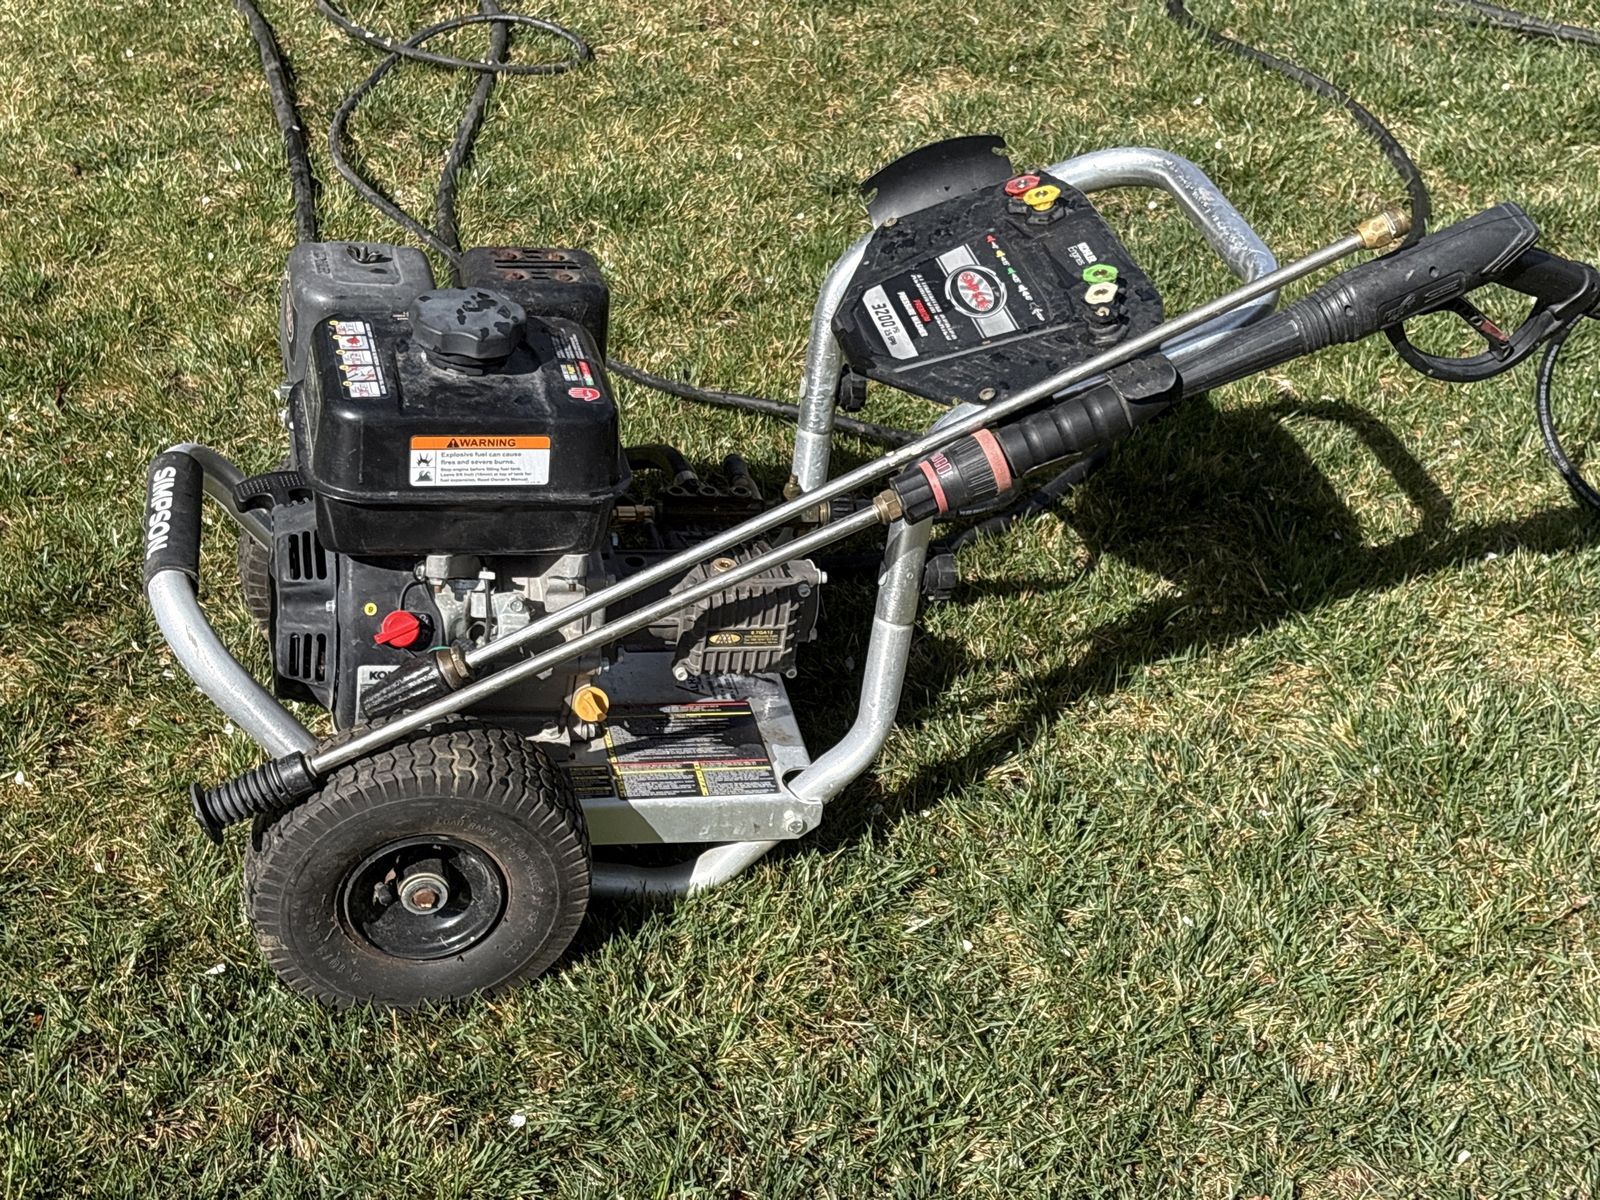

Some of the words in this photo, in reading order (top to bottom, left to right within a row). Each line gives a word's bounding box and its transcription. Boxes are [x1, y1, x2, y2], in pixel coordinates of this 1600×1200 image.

[871, 303, 896, 328] 3200
[460, 438, 516, 447] WARNING
[146, 466, 177, 560] SIMPSON
